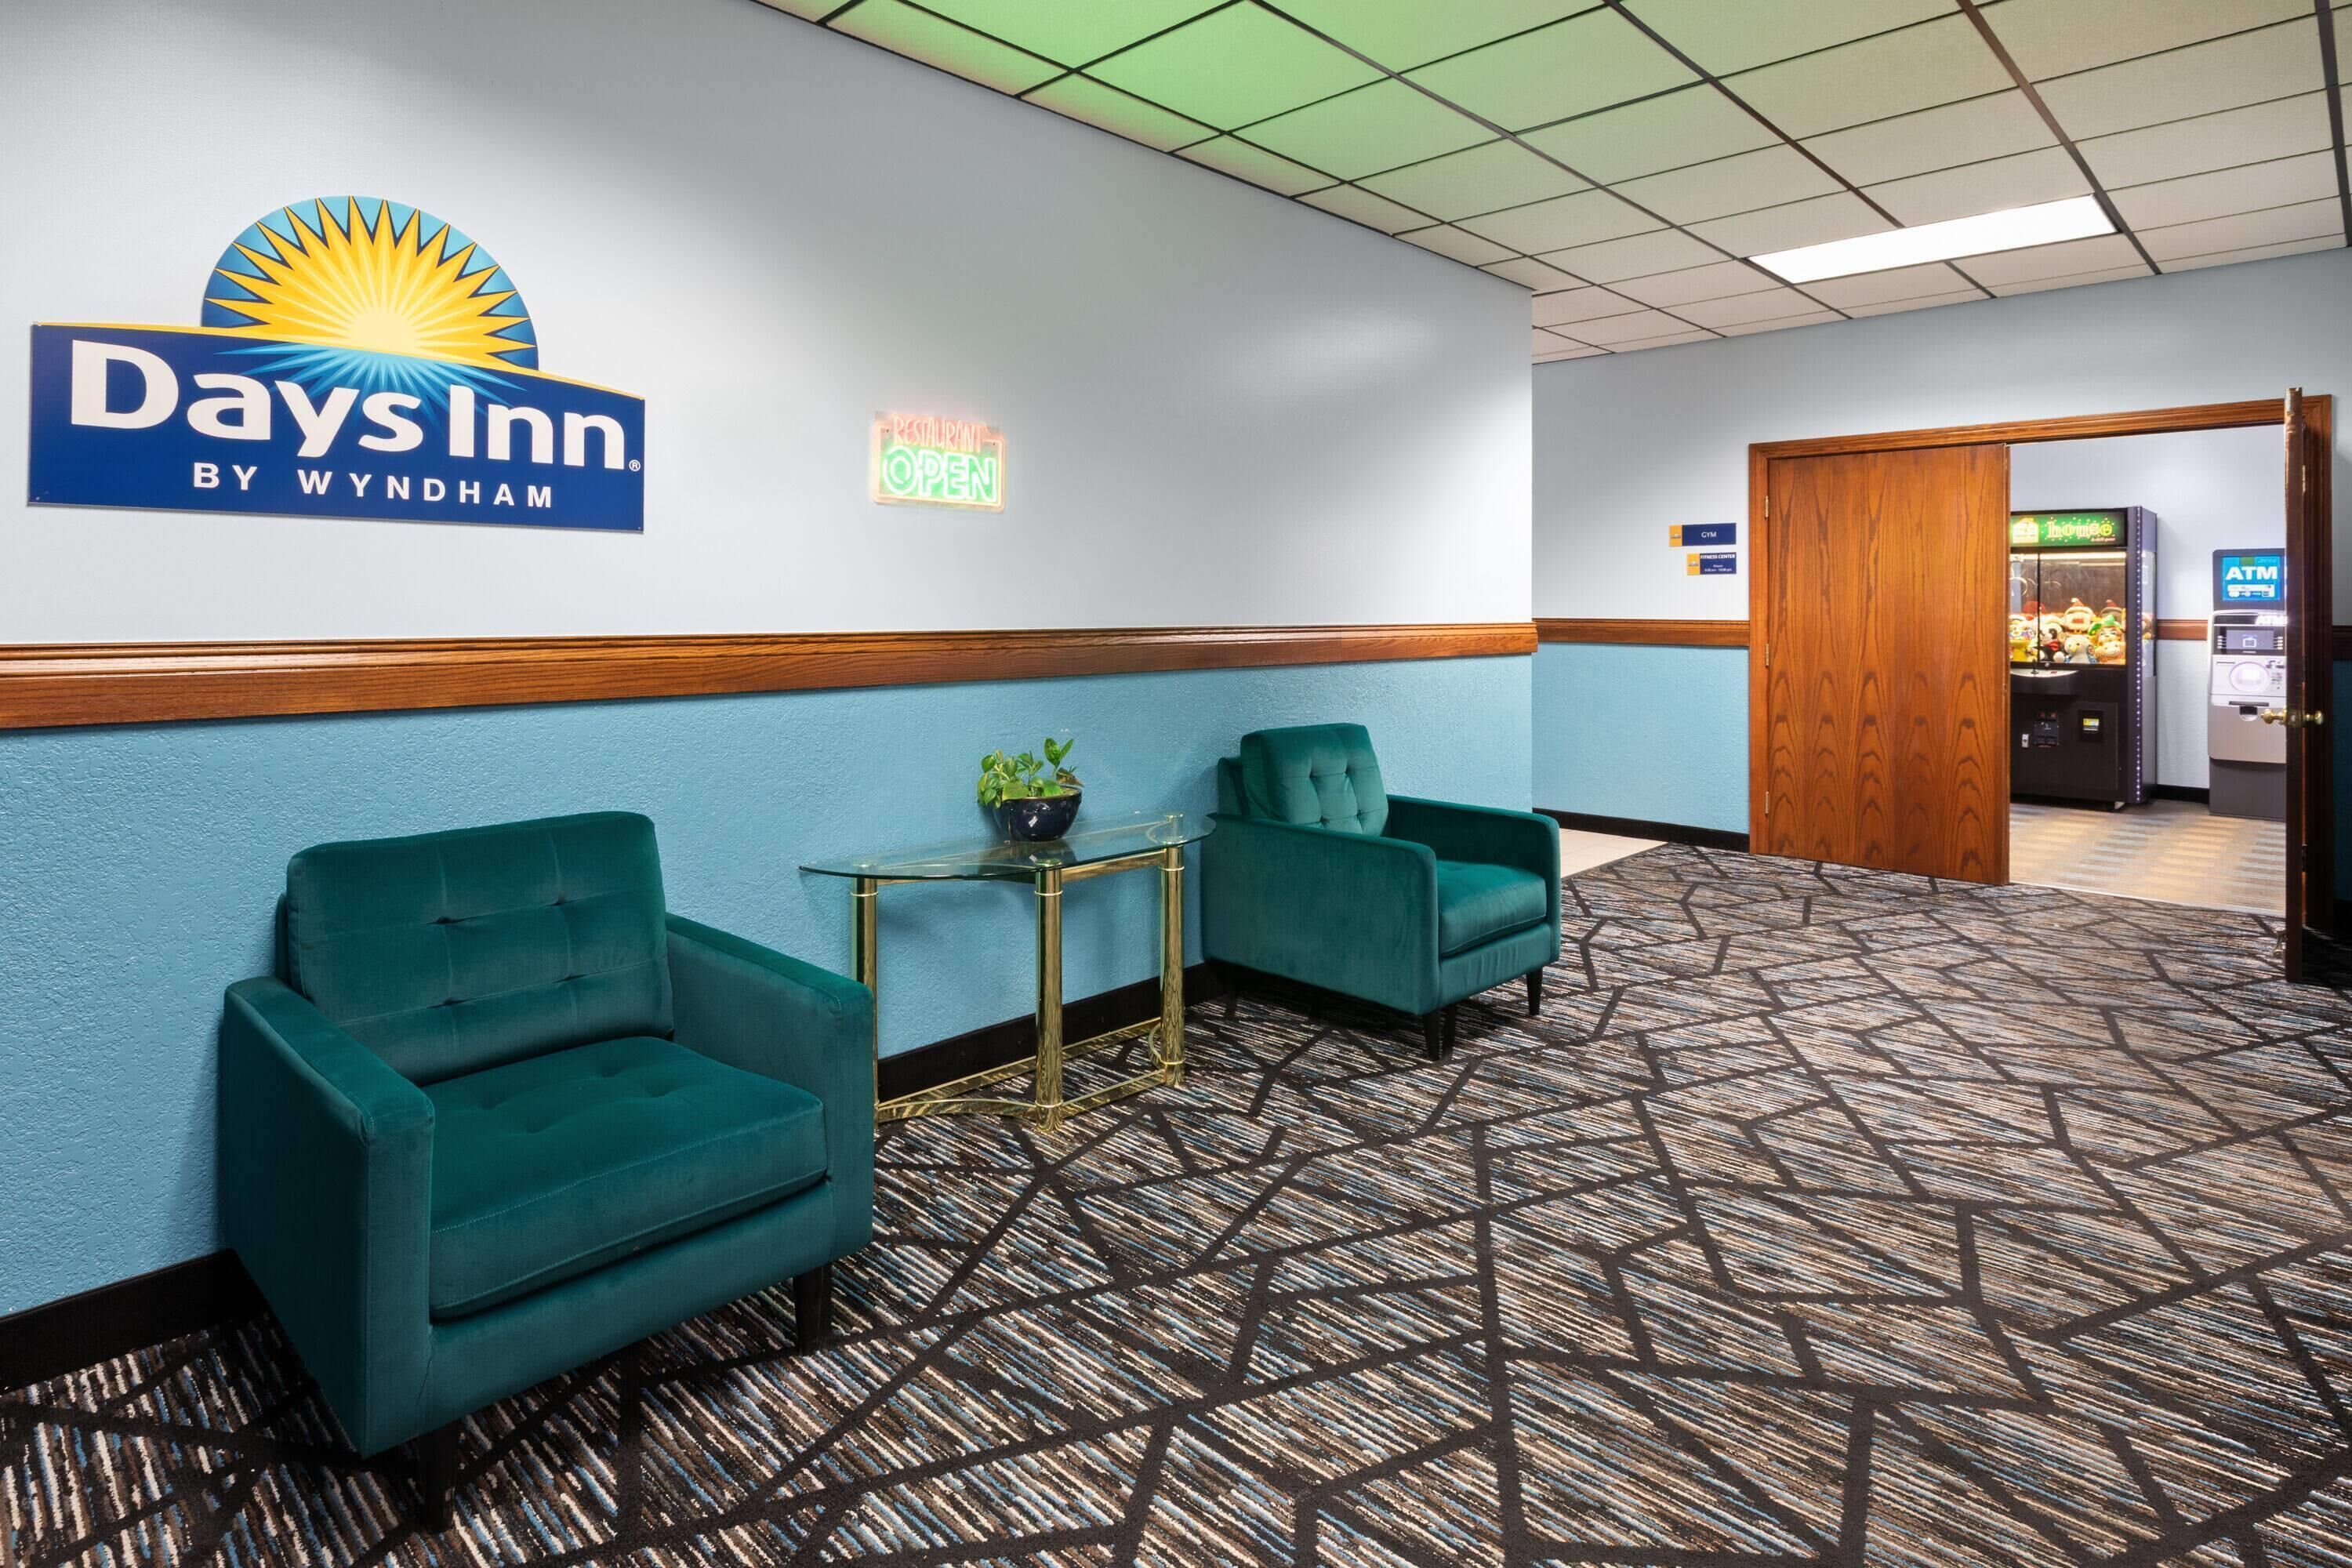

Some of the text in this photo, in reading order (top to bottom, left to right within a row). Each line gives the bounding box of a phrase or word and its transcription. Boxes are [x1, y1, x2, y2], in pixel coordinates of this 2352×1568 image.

[71, 339, 423, 458] Days
[892, 416, 982, 453] RESTAURANT
[194, 463, 553, 509] BY WYNDHAM
[882, 445, 997, 503] OPEN
[2046, 521, 2113, 539] house
[2225, 566, 2278, 580] ATM
